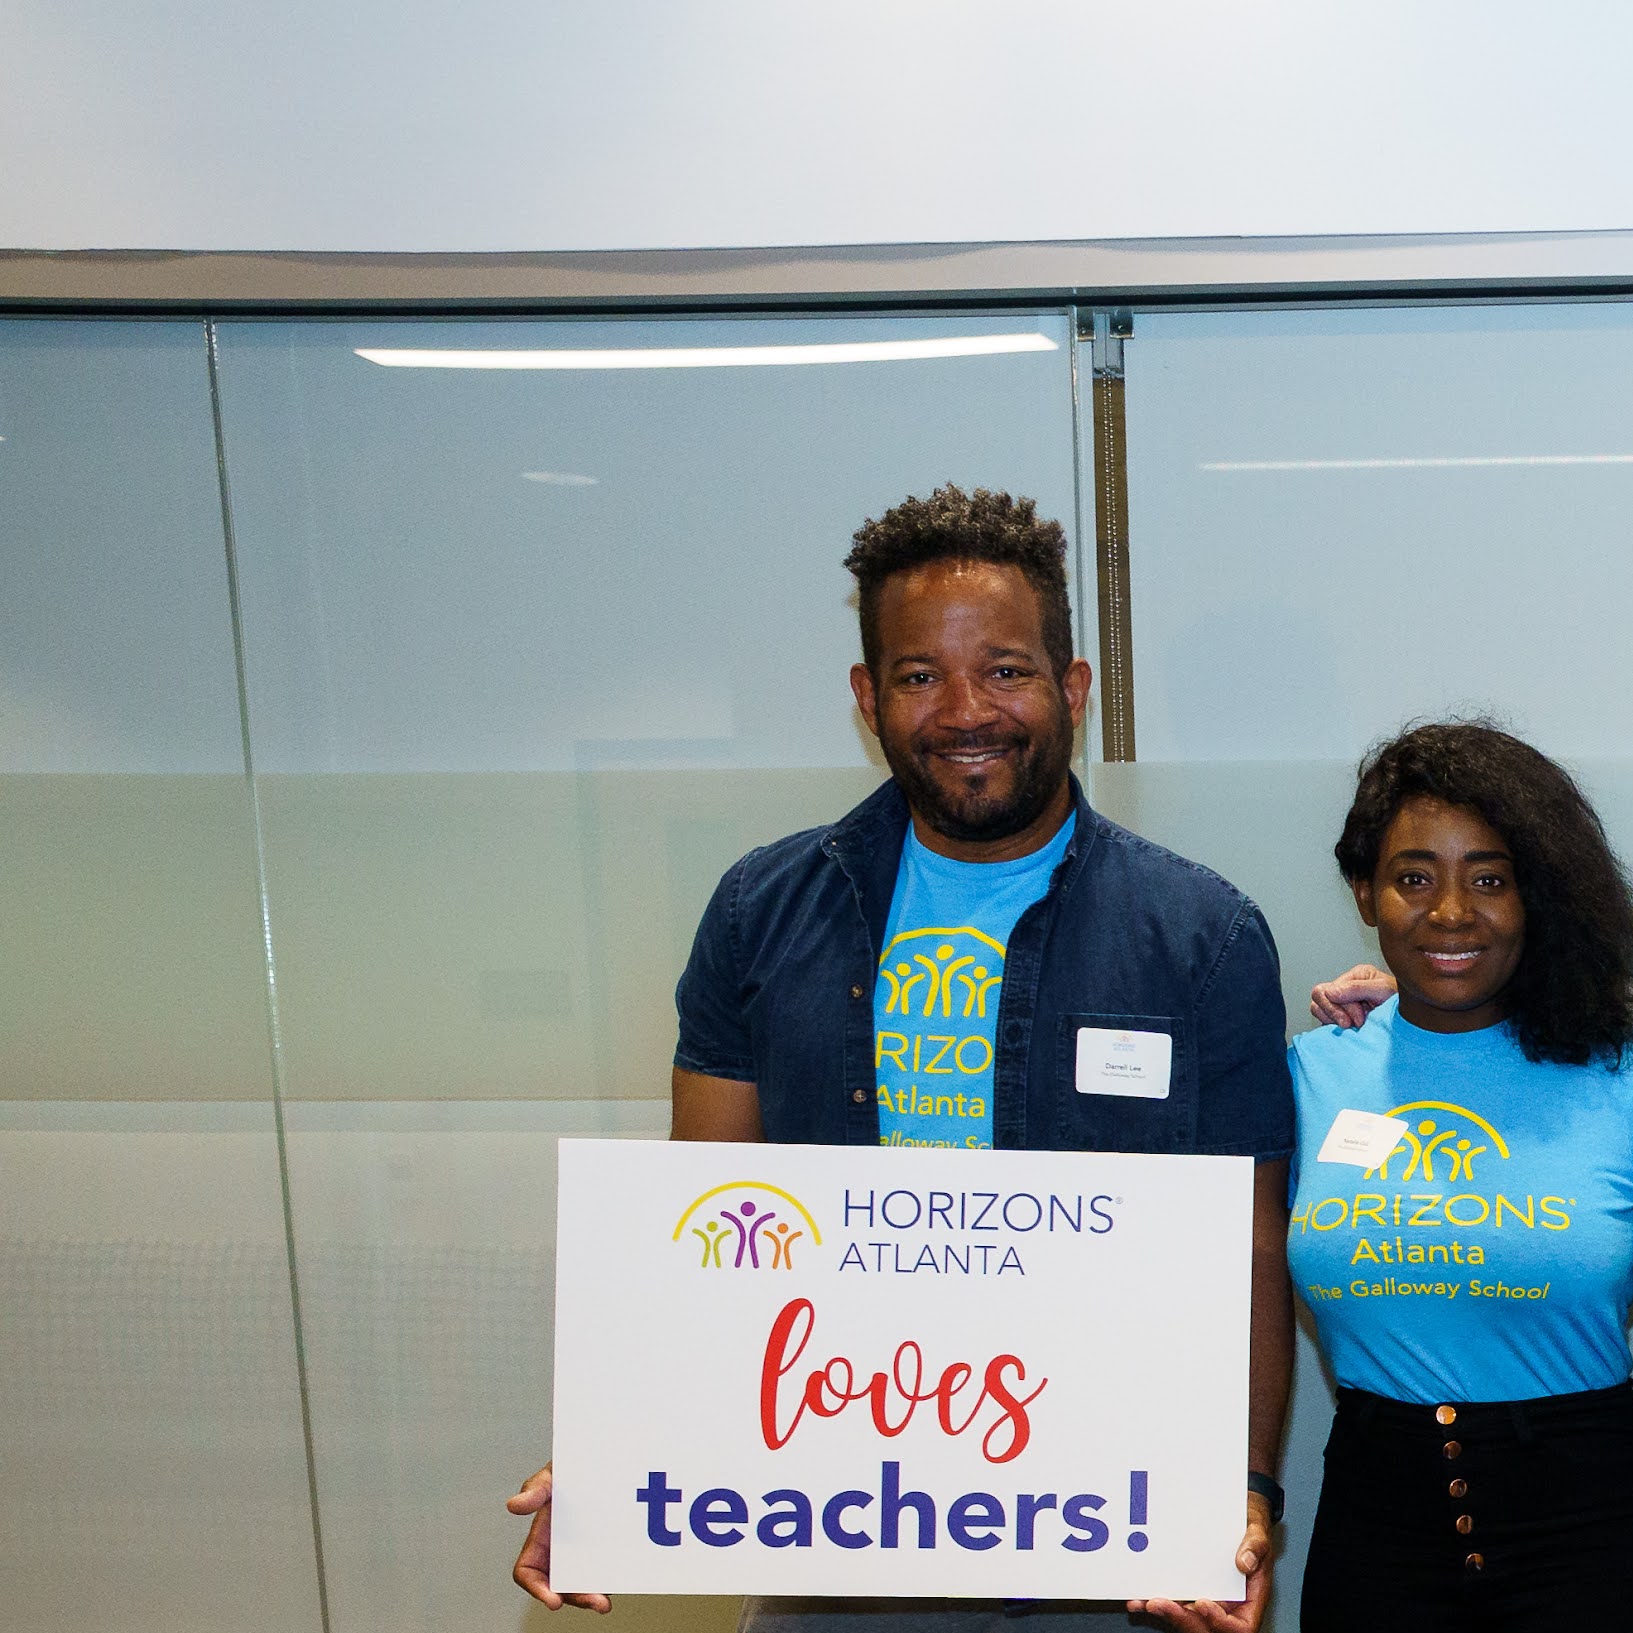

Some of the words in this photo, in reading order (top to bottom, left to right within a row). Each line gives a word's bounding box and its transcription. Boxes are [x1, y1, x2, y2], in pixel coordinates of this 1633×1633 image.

[875, 1031, 994, 1075] RIZO
[876, 1084, 985, 1118] Atlanta
[844, 1189, 1115, 1234] HORIZONS
[839, 1242, 1025, 1276] ATLANTA
[1350, 1236, 1485, 1265] Atlanta
[1308, 1283, 1342, 1300] The
[1350, 1276, 1460, 1299] Galloway
[1468, 1279, 1550, 1299] School
[760, 1297, 1048, 1464] loves
[636, 1461, 1149, 1553] teachers!
